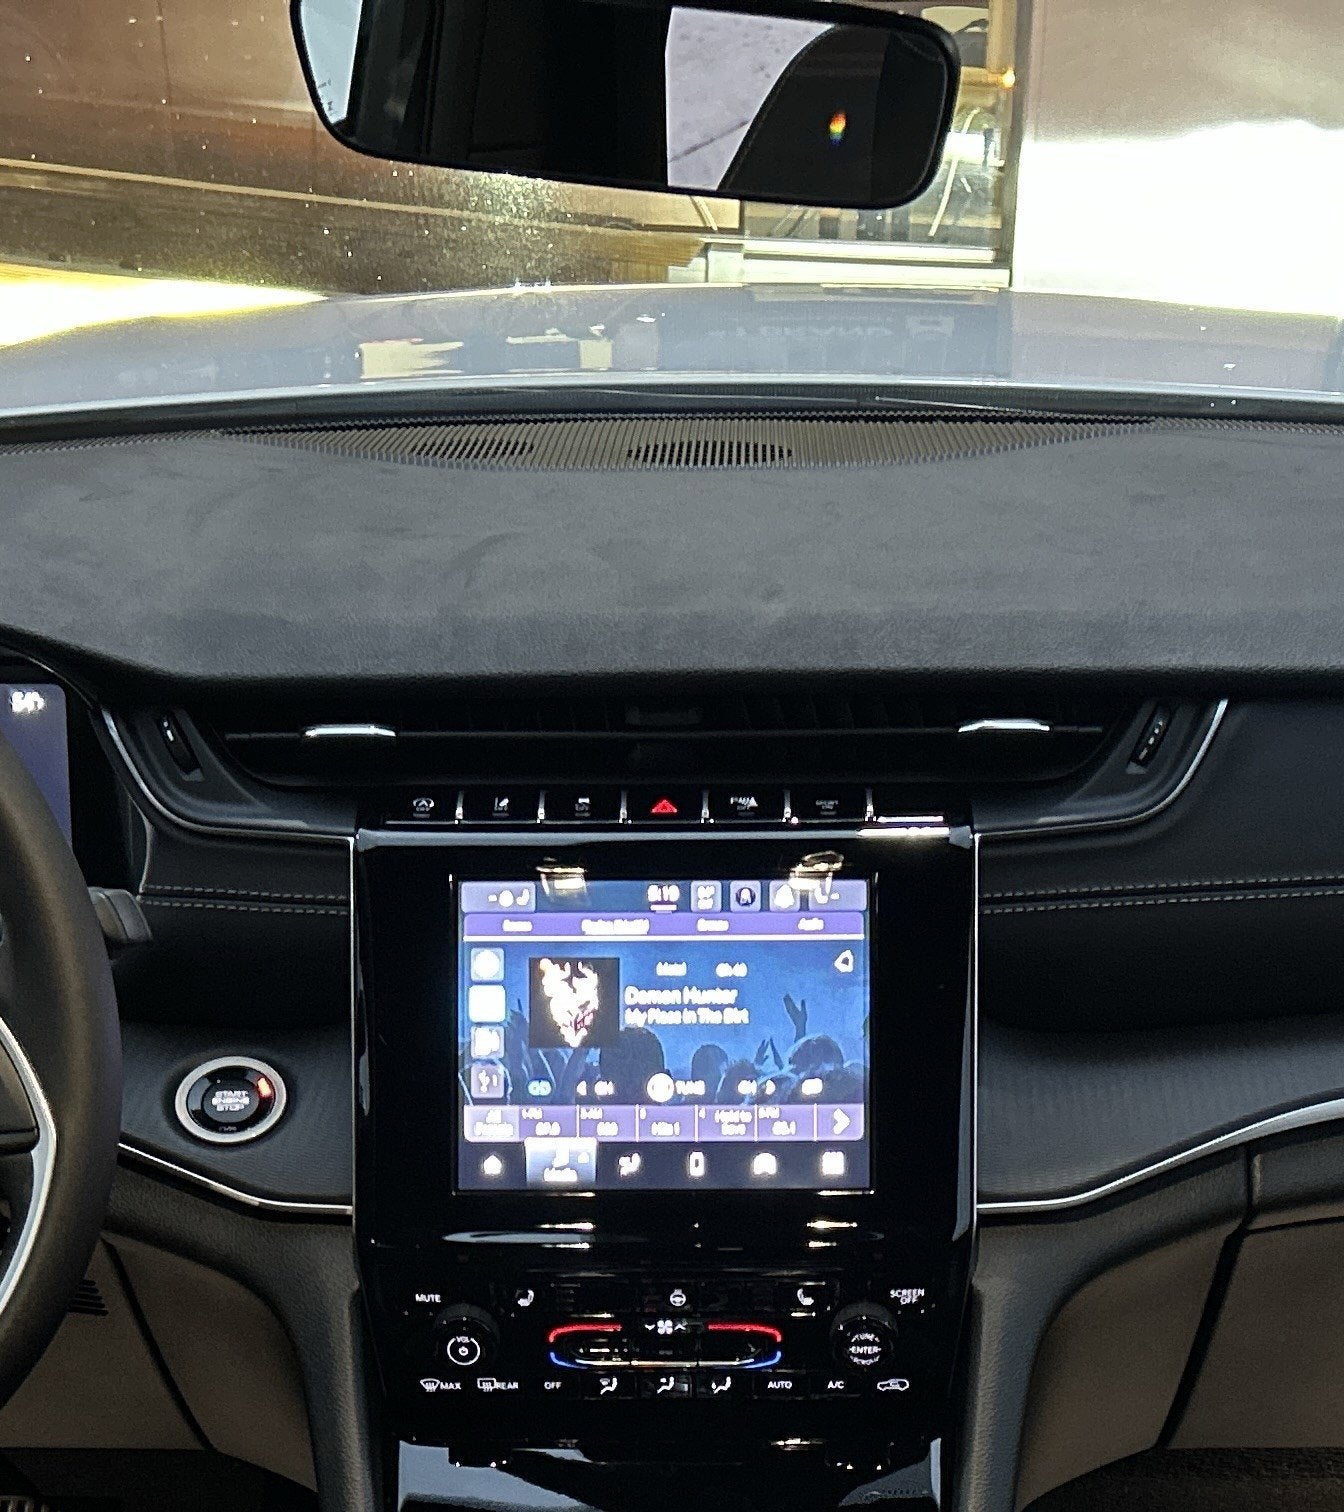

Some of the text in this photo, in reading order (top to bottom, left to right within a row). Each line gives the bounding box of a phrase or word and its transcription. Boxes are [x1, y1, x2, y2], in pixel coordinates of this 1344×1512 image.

[889, 1287, 925, 1298] SCREEN
[415, 1293, 442, 1303] MUTE
[439, 1381, 462, 1391] MAX
[496, 1381, 519, 1390] REAR
[543, 1381, 563, 1390] OFF
[767, 1380, 794, 1390] AUTO
[827, 1380, 846, 1390] A/C
